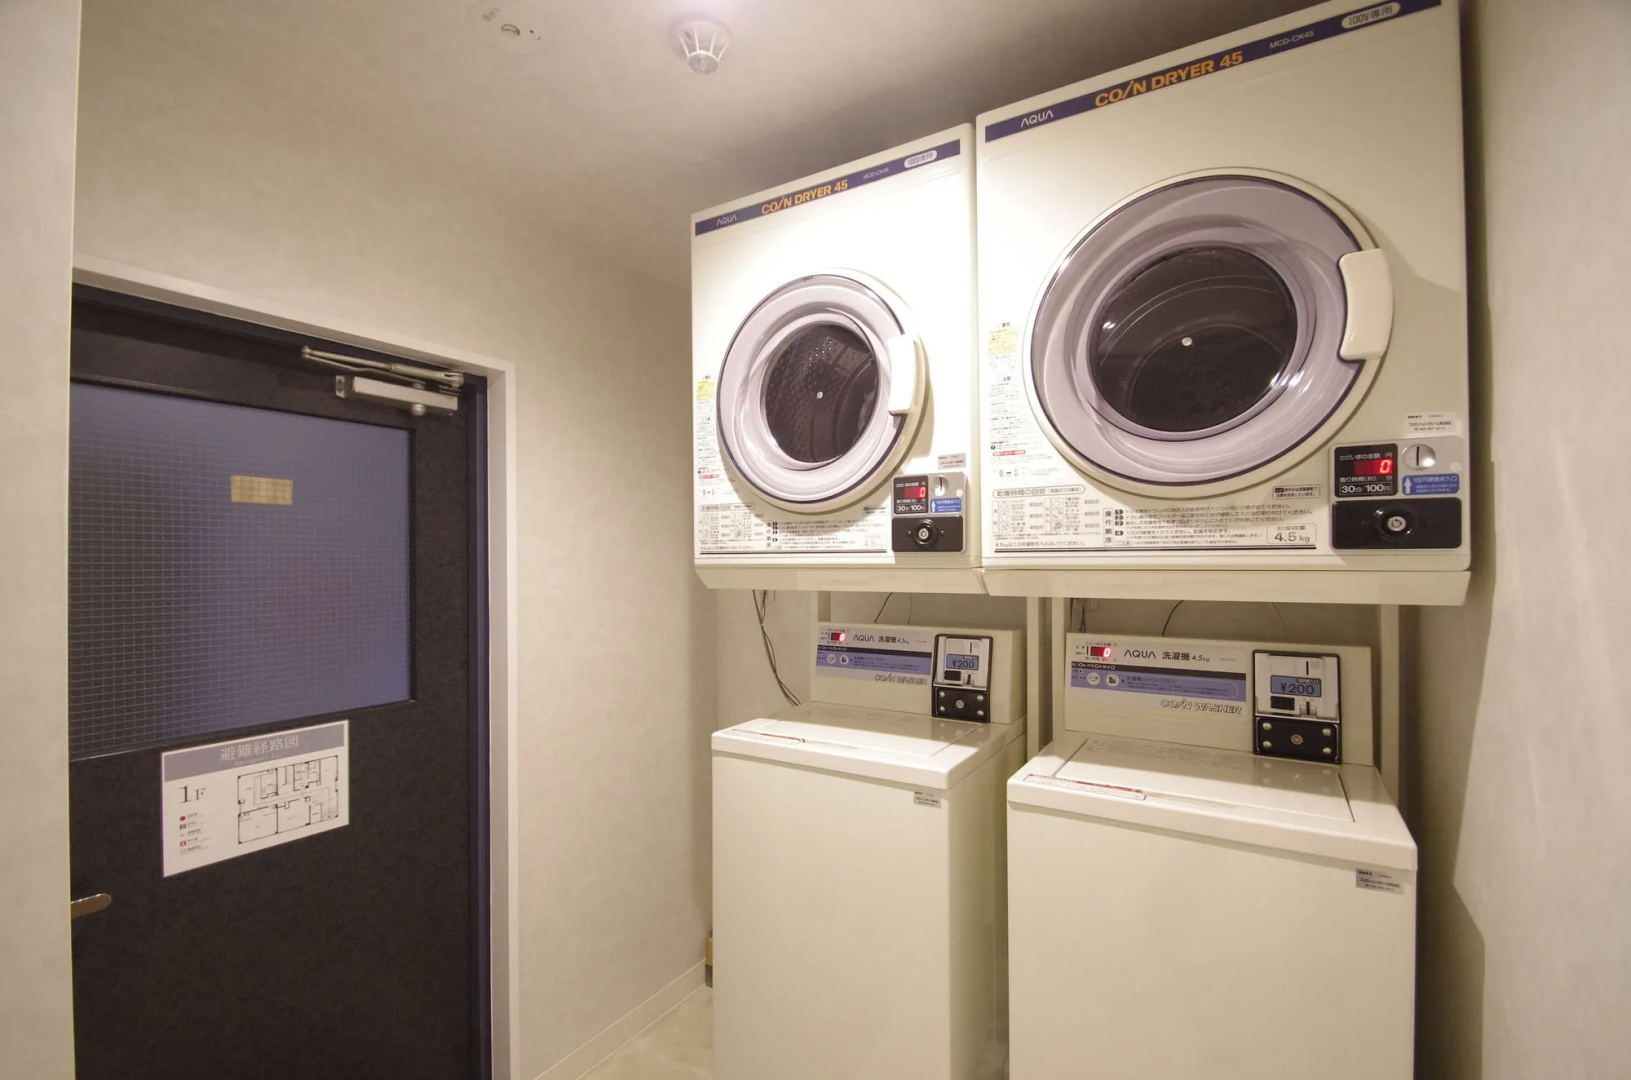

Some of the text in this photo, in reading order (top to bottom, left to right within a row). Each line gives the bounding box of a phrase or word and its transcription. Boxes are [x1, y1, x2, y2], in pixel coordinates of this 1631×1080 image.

[1020, 29, 1315, 128] AQUA COIN DRYER 45 MCD-CK45
[716, 214, 738, 227] AQUA
[761, 196, 793, 215] COIN
[794, 184, 832, 206] DRYER
[833, 179, 849, 193] 45
[1379, 459, 1391, 474] 0
[919, 486, 926, 498] 0
[1274, 532, 1298, 543] 4.5
[1299, 535, 1311, 544] kg
[852, 634, 875, 643] AQUA
[1103, 647, 1111, 658] 0
[1124, 649, 1157, 660] AQUA
[1162, 651, 1190, 661] 洗濯機
[951, 659, 975, 669] ¥200
[1279, 681, 1315, 695] ¥200
[1194, 701, 1242, 715] WASHER
[219, 734, 299, 762] 避難経路図
[179, 784, 207, 804] 1F
